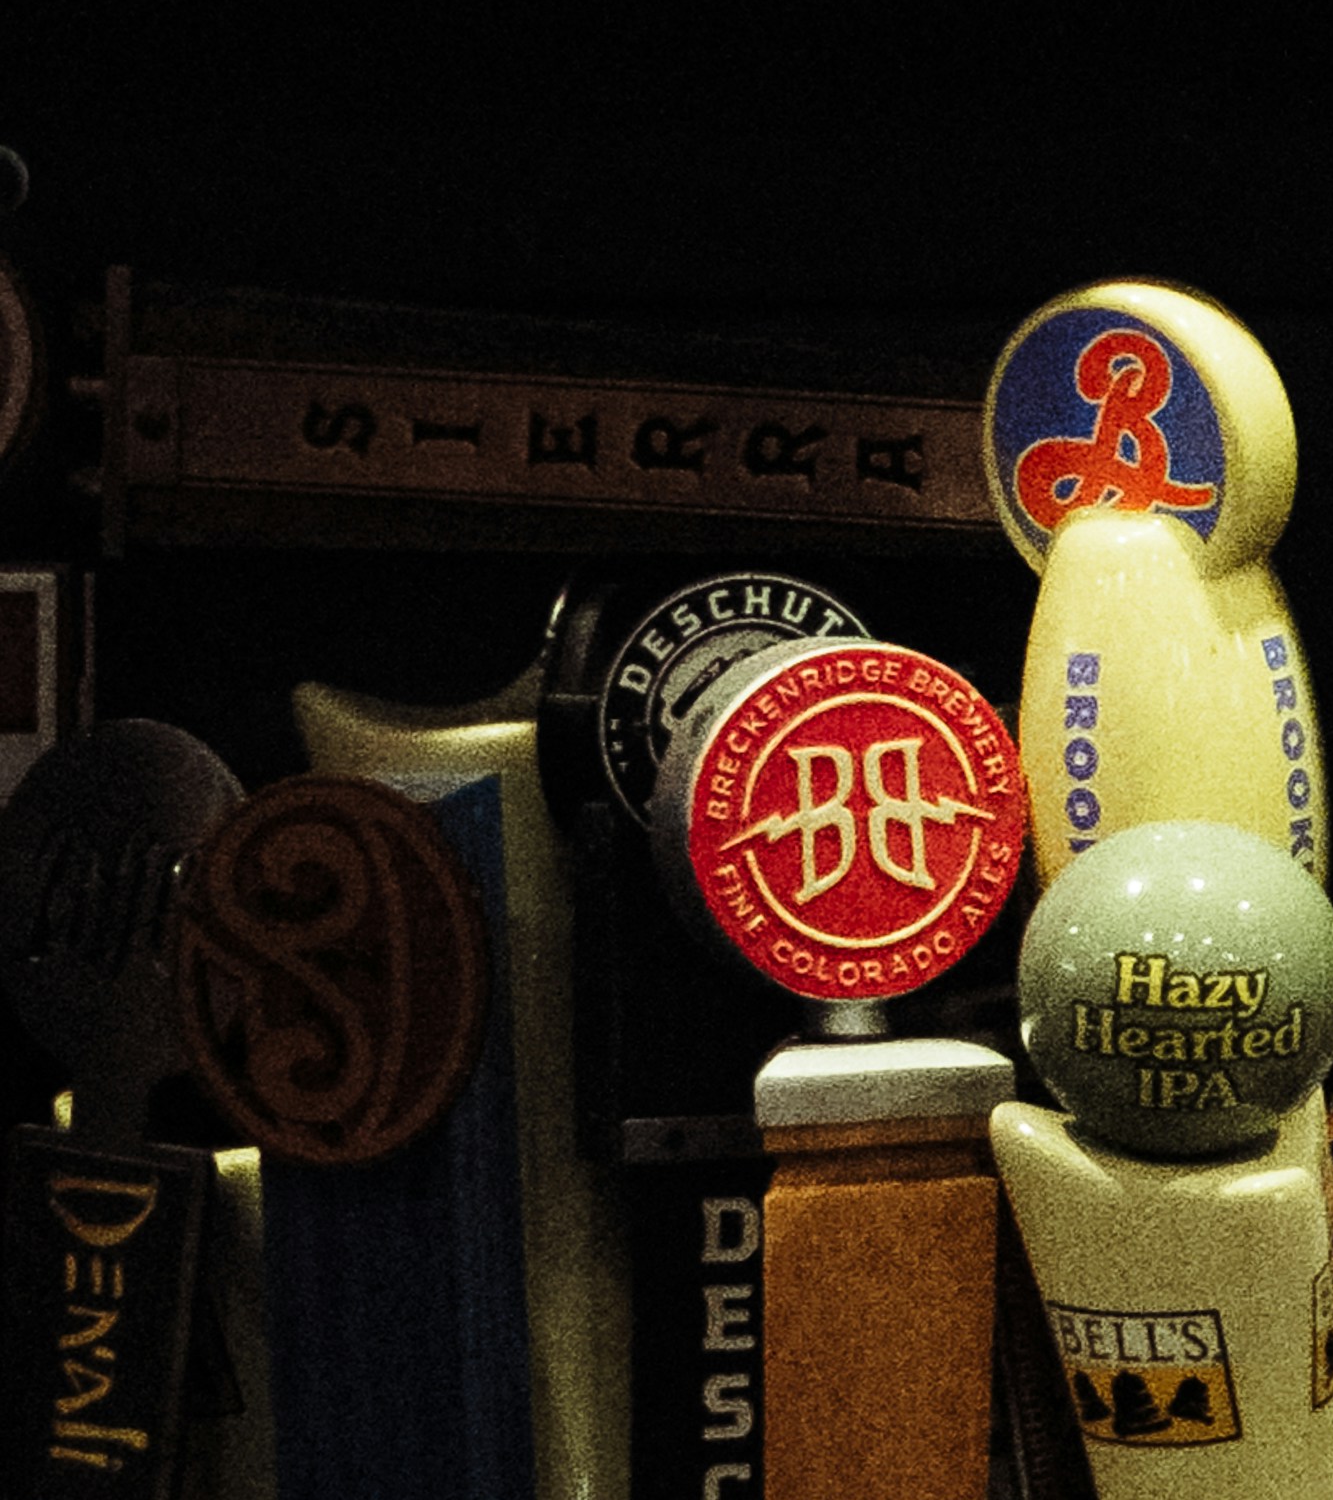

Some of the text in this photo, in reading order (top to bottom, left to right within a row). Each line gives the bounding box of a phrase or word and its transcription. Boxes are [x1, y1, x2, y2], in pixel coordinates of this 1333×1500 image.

[301, 400, 924, 487] SIERRA
[616, 584, 850, 701] DESCHUT
[705, 657, 904, 823] BRECKENRIDGE
[905, 668, 1012, 798] BREWERY
[713, 840, 1013, 988] FINE COLORADO ALES
[1114, 953, 1270, 1014] Hazy
[1072, 1003, 1305, 1060] Hearted
[1136, 1068, 1237, 1111] IPA
[1058, 1319, 1213, 1363] BELL'S
